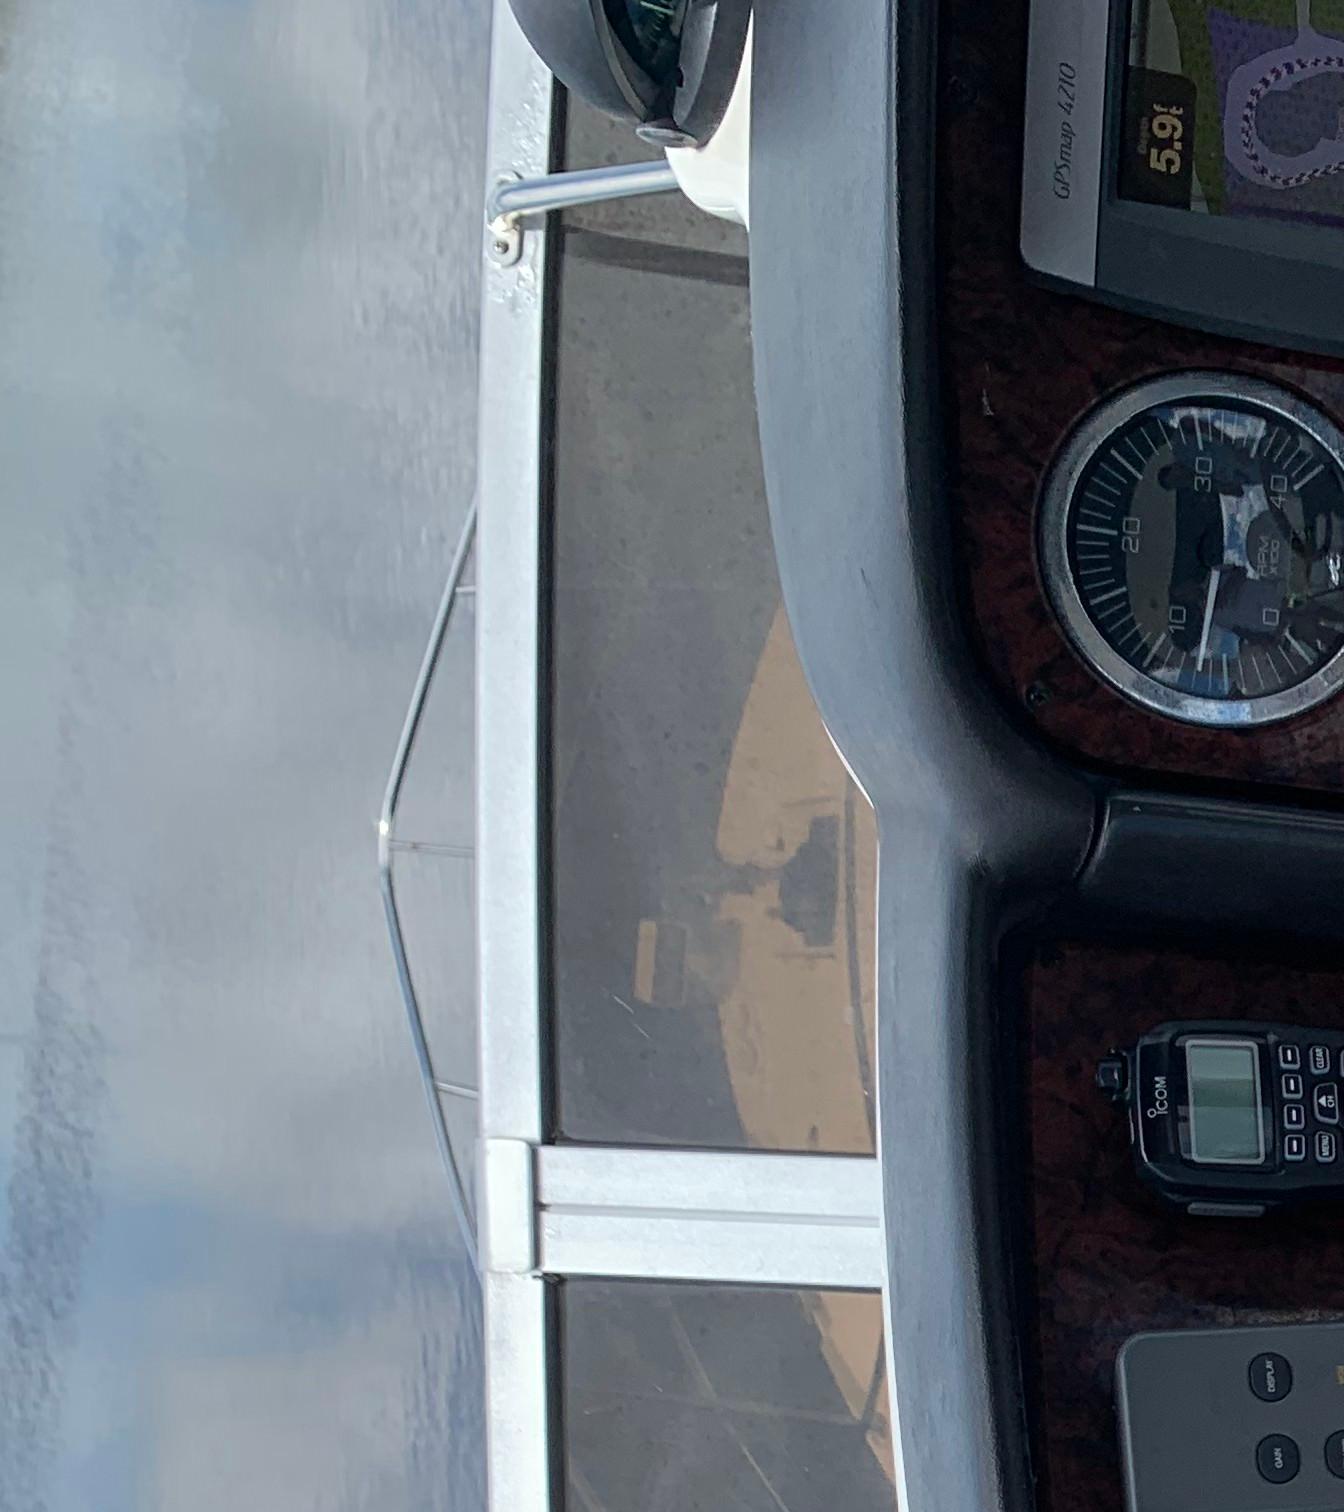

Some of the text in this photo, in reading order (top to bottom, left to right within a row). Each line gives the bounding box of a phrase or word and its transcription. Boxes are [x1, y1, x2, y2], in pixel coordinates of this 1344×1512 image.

[1053, 62, 1077, 199] GPSmap 4210
[1149, 113, 1184, 175] 5.9
[1193, 456, 1213, 493] 30
[1270, 475, 1288, 509] 40
[1120, 517, 1141, 553] 20
[1167, 606, 1187, 634] 10
[1262, 608, 1280, 626] 0
[1315, 1047, 1325, 1069] CLEAR
[1327, 1095, 1335, 1109] CH
[1321, 1135, 1330, 1157] MENU
[1265, 1359, 1276, 1393] DISPLAY
[1273, 1447, 1285, 1469] GAIN
